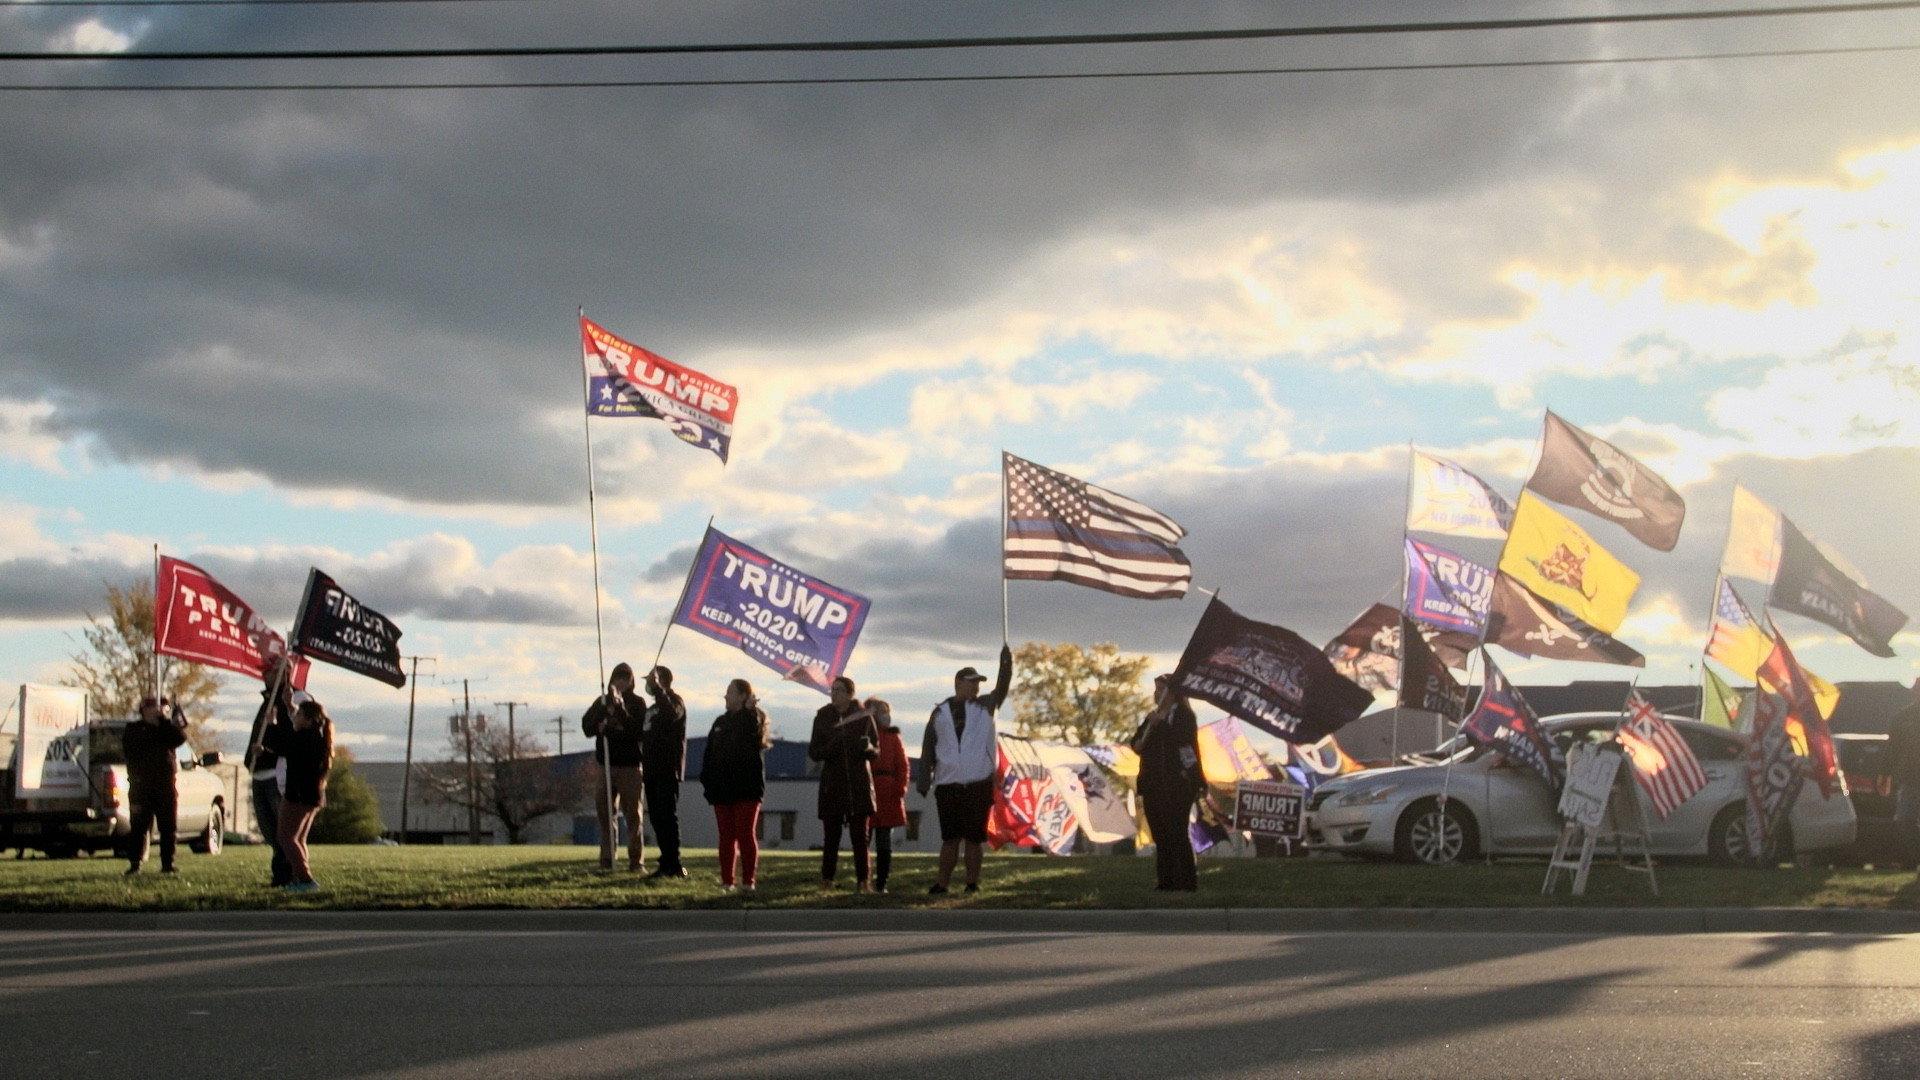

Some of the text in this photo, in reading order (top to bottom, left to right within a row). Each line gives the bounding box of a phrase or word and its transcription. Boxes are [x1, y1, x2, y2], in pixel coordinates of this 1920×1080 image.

[723, 551, 848, 630] TRUMP
[701, 605, 733, 625] KEEP
[733, 619, 784, 654] AMERICA
